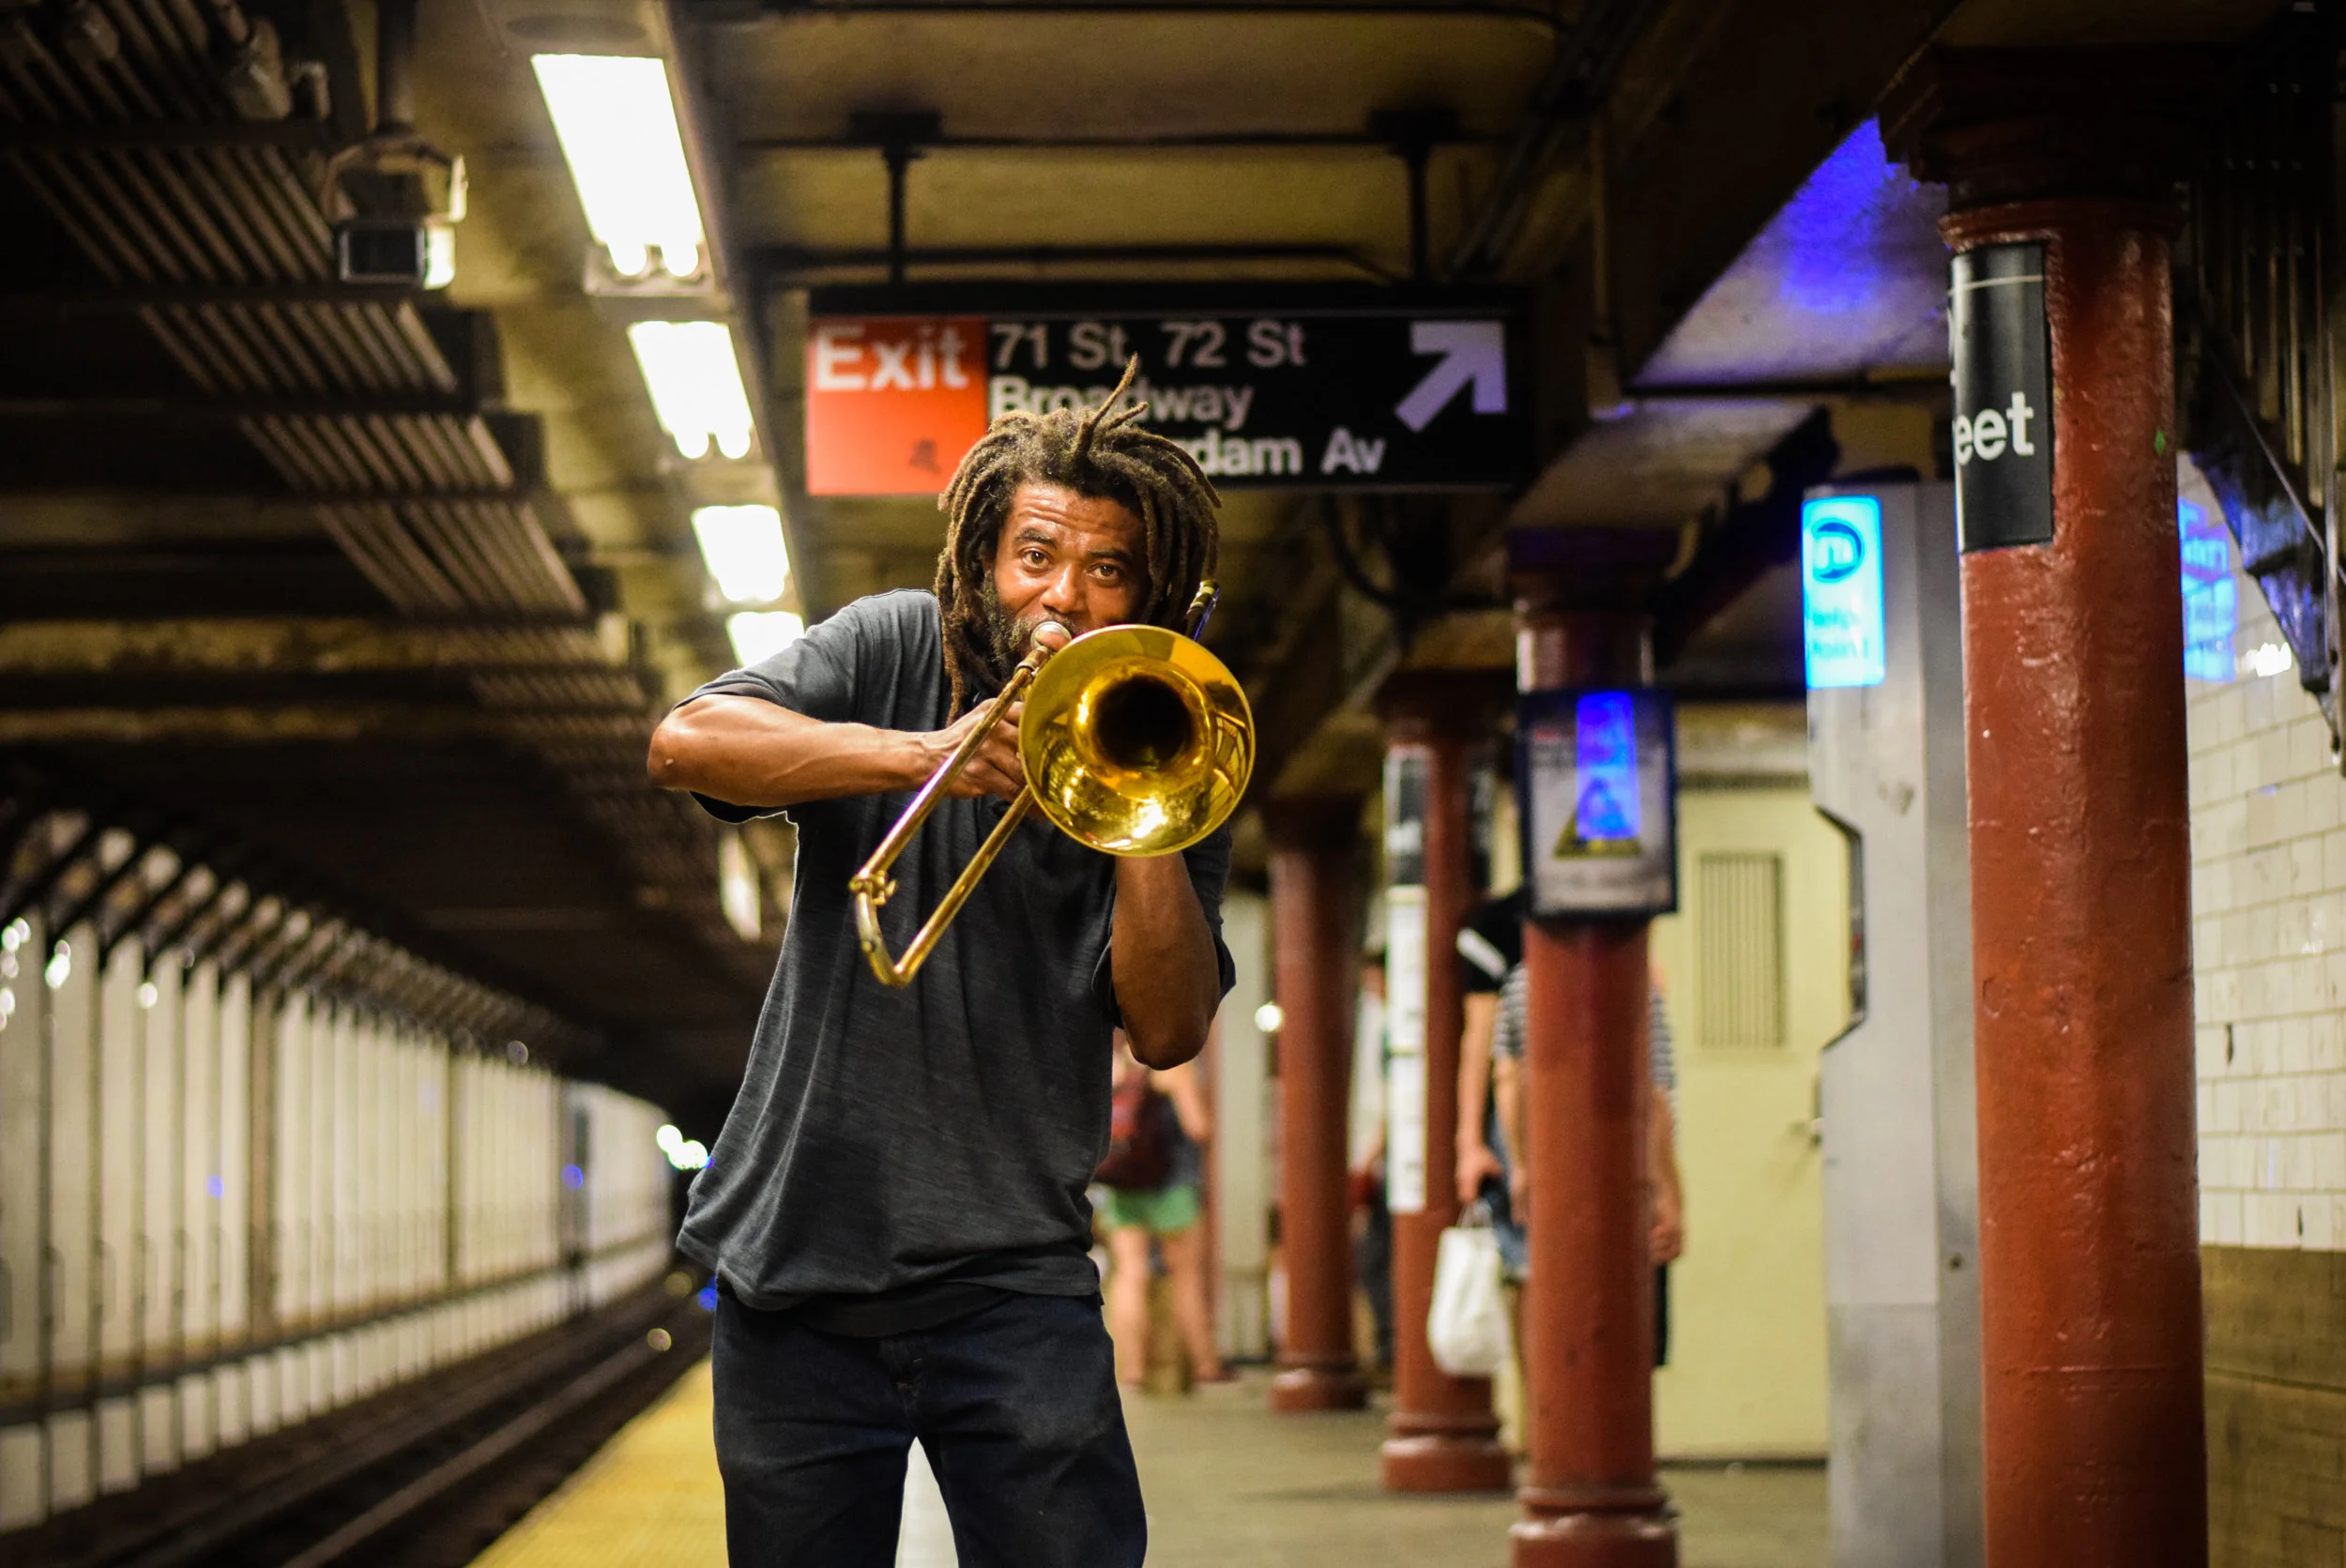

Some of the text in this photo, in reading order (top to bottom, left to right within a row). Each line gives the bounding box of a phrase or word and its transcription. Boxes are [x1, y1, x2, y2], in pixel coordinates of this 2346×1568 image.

[815, 326, 968, 390] Exit
[992, 324, 1049, 369] 71
[1161, 324, 1226, 367] 72
[1246, 321, 1307, 368] St
[1320, 427, 1386, 474] Av
